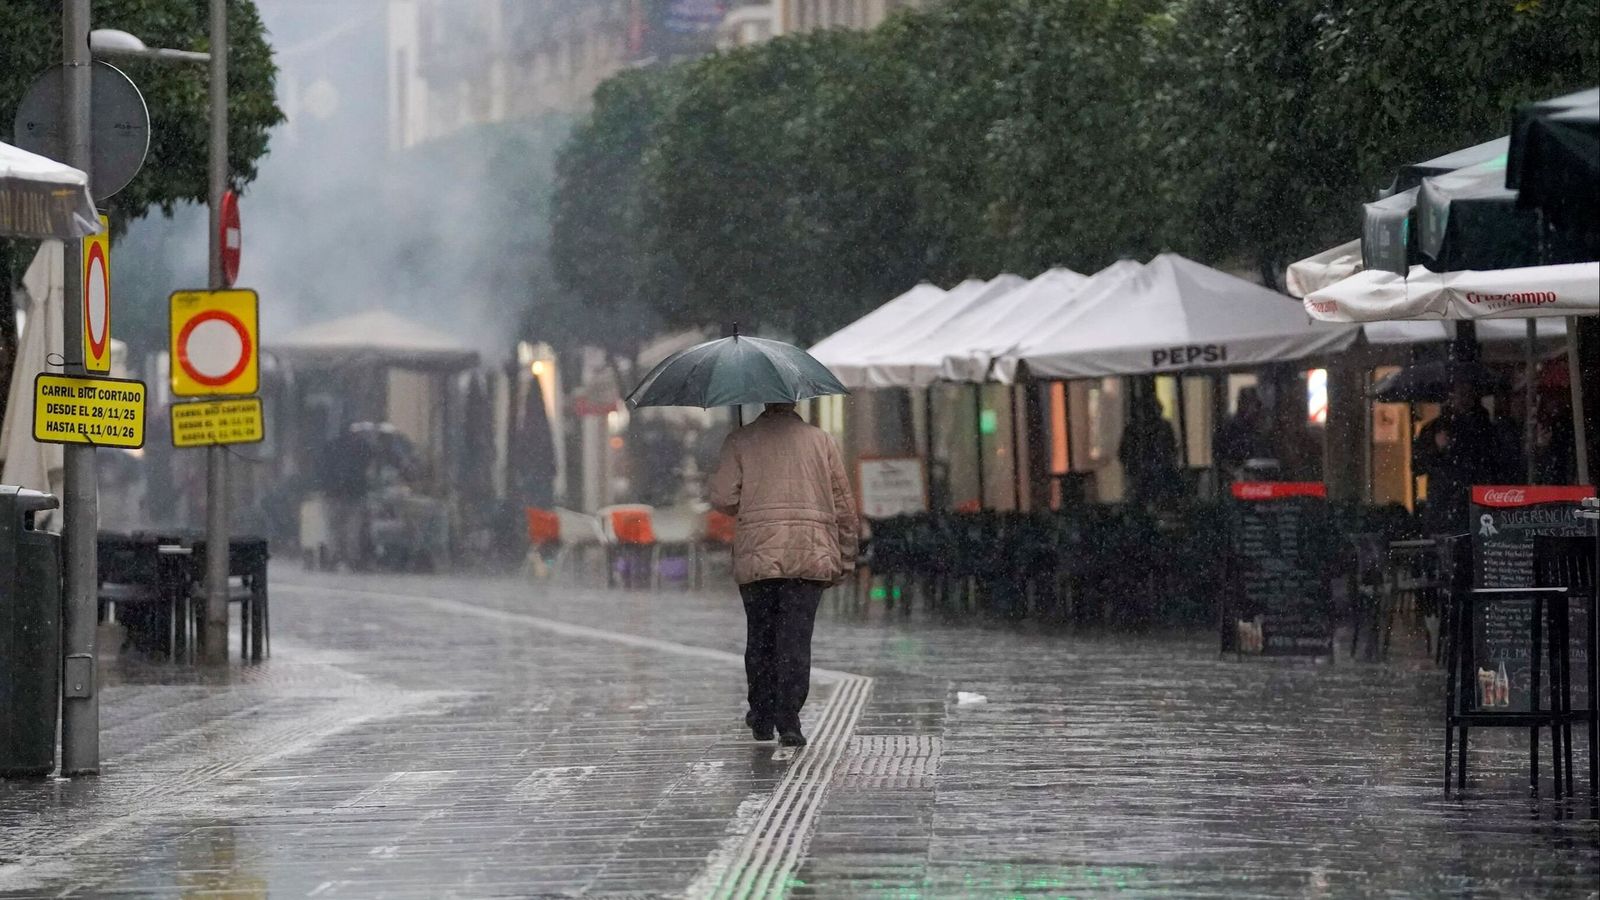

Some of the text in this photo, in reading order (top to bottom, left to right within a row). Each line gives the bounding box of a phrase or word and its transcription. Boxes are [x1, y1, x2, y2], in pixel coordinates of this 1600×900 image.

[1152, 344, 1227, 366] PEPSI
[42, 385, 141, 403] CARRIL BICI CORTADO
[46, 403, 135, 420] DESDE EL 28/11/25
[46, 421, 134, 438] HASTA EL 11/01/26
